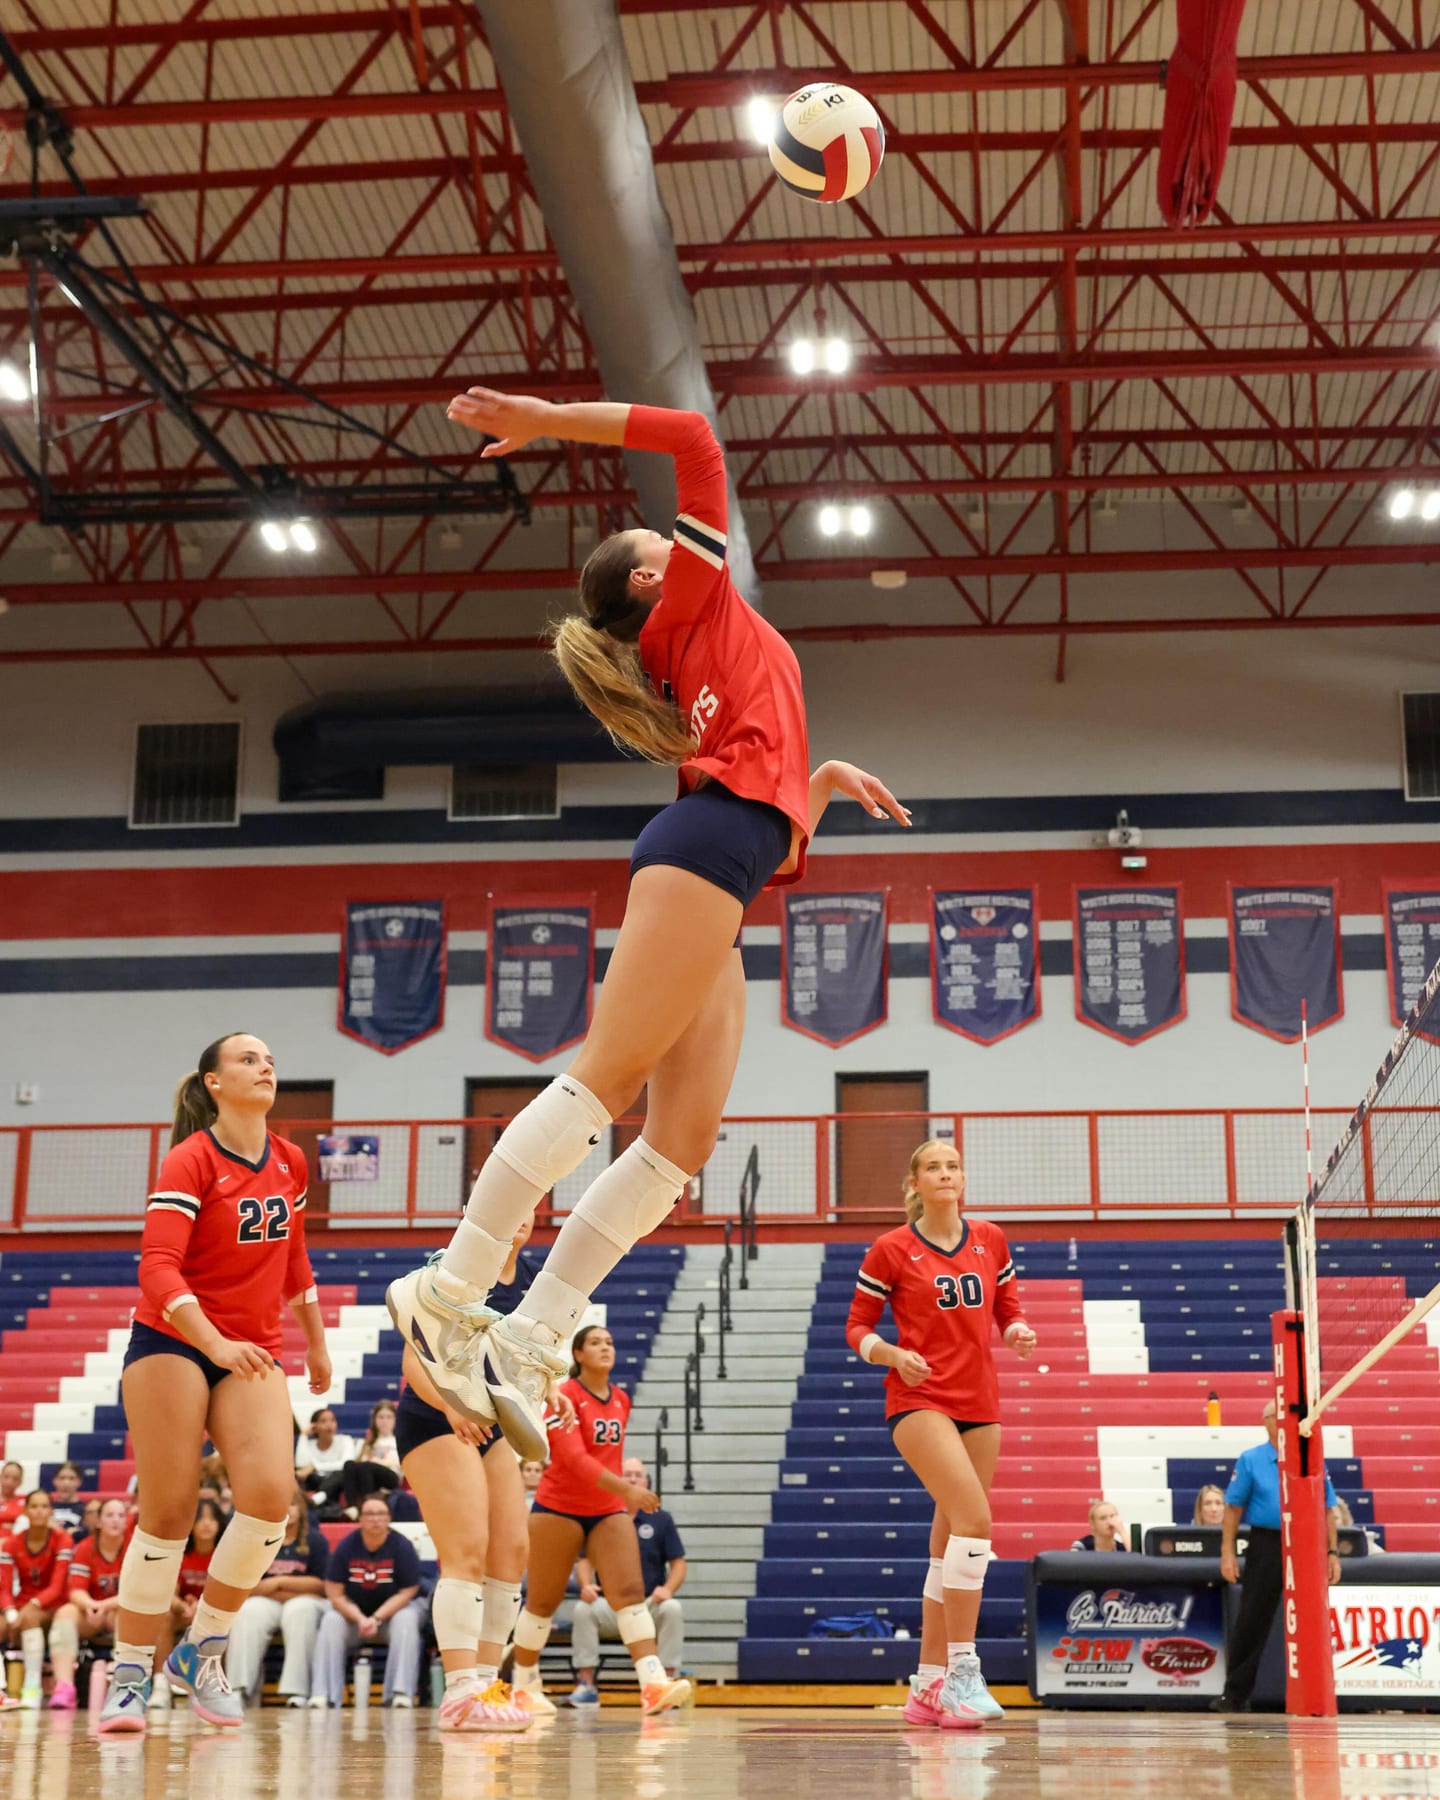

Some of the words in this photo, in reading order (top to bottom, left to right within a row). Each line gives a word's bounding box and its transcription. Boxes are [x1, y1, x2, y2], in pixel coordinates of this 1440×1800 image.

[237, 1195, 291, 1244] 22
[934, 1272, 983, 1310] 30
[594, 1418, 622, 1446] 23
[1274, 1343, 1299, 1679] HERITAGE
[1175, 1541, 1203, 1552] BONUS
[1068, 1592, 1096, 1631] Go
[1067, 1663, 1131, 1673] INSULATION
[1343, 1680, 1377, 1688] HOUSE
[1382, 1680, 1434, 1688] HERITAGE
